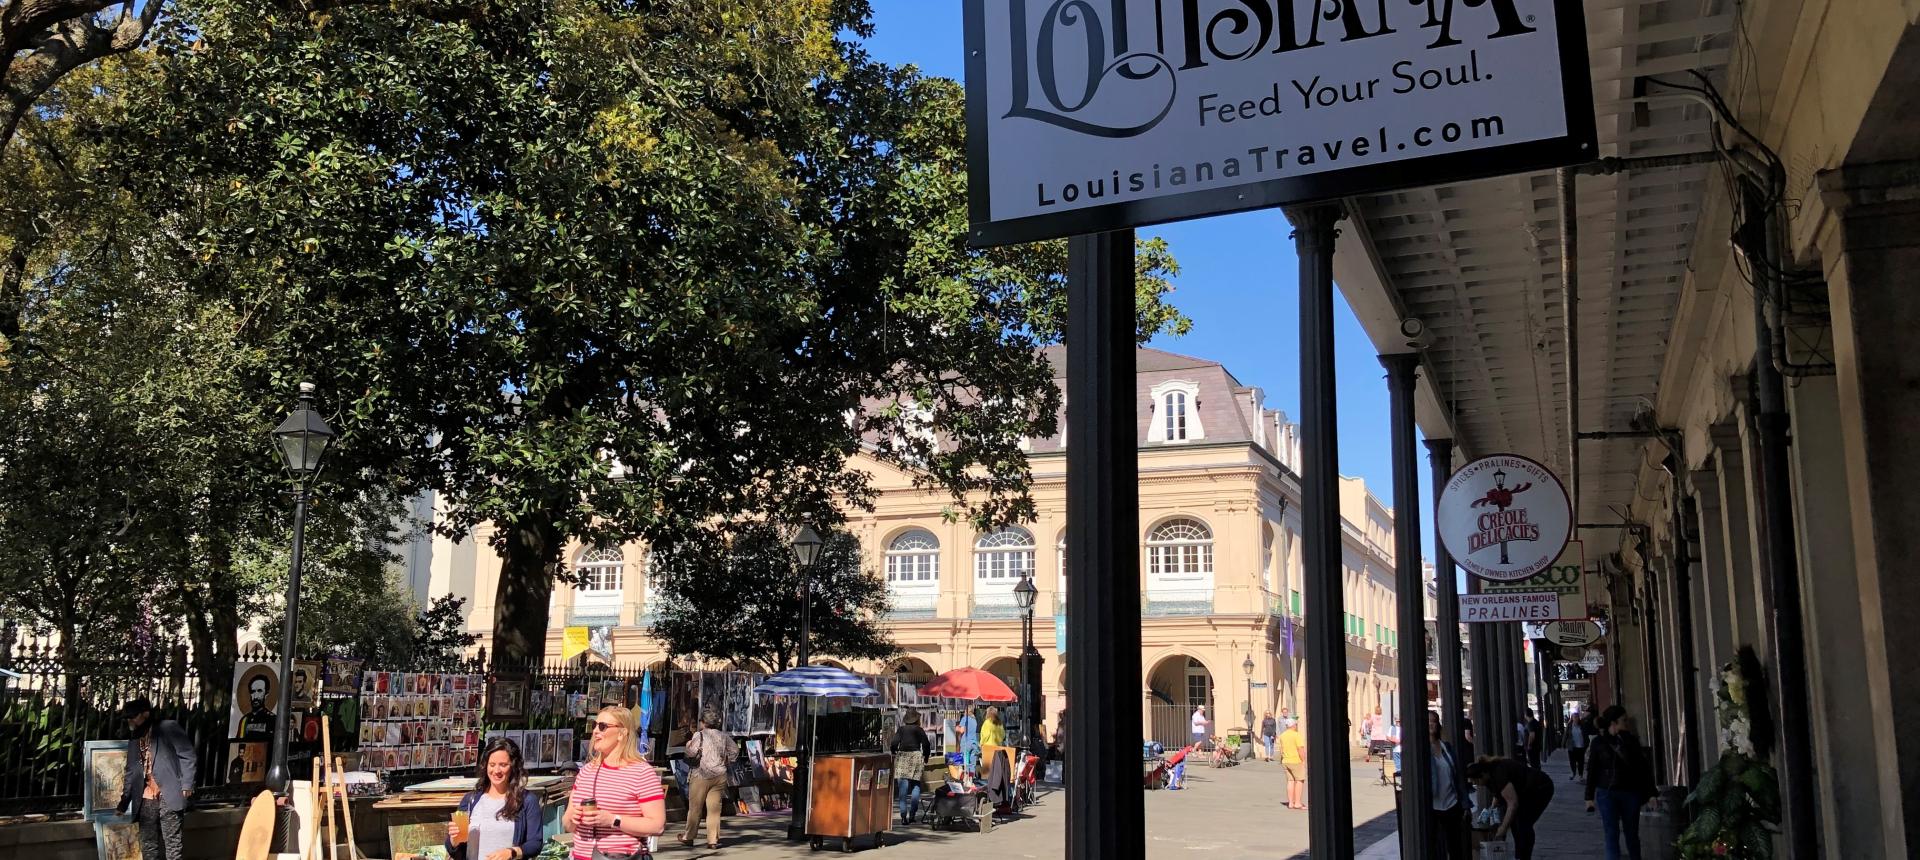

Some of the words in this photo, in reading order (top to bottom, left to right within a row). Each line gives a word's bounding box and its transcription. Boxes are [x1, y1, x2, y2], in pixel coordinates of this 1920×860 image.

[1198, 83, 1282, 126] Feed
[1291, 75, 1380, 109] Your
[1392, 49, 1493, 94] Soul.
[1038, 115, 1504, 207] LouisianaTravel.com
[1450, 468, 1475, 492] SPICES
[1478, 459, 1520, 471] PRALINES
[1526, 465, 1549, 483] GIFTS
[1478, 508, 1527, 532] CREOLE
[1468, 523, 1540, 551] DELICACIES
[1465, 558, 1484, 575] FAMILY
[1485, 569, 1507, 578] OWNED
[1508, 566, 1534, 578] KITCHEN
[1535, 555, 1549, 570] SHOP
[1462, 597, 1480, 605] NEW
[1482, 596, 1520, 604] ORLEANS
[1522, 595, 1556, 603] FAMOUS
[1468, 605, 1550, 619] PRALINES
